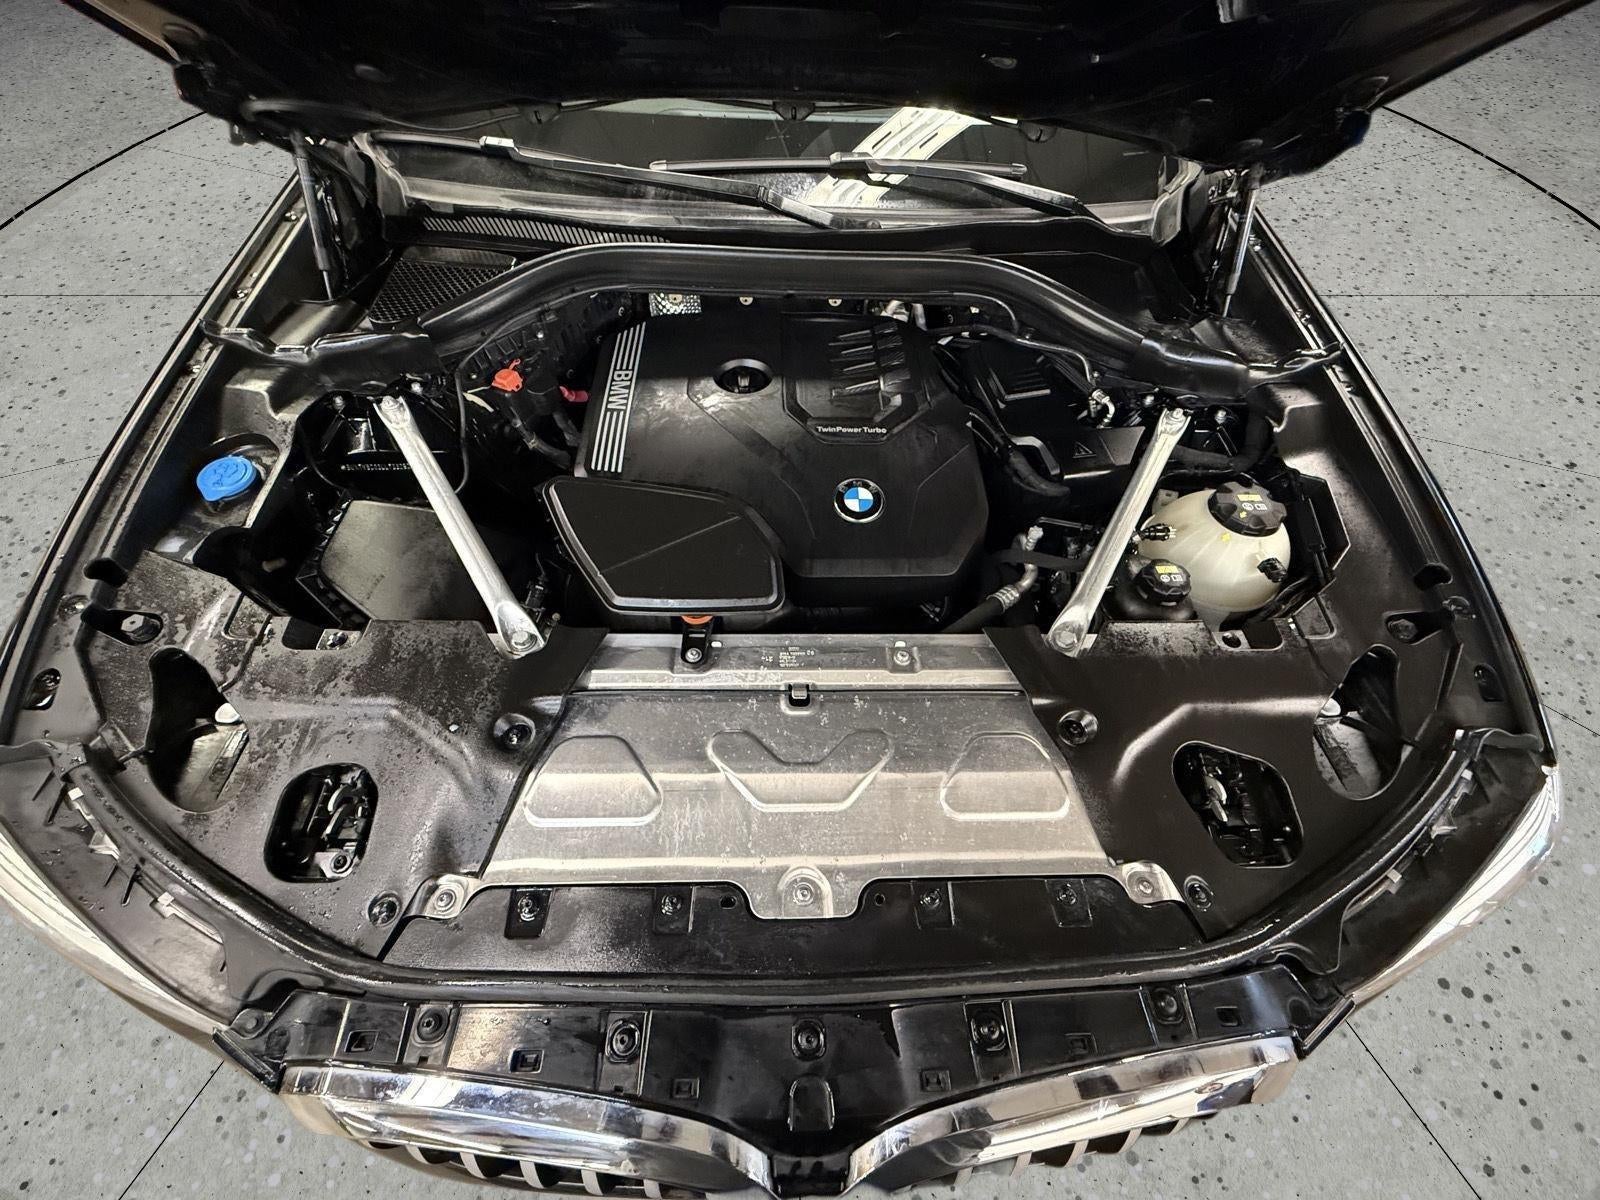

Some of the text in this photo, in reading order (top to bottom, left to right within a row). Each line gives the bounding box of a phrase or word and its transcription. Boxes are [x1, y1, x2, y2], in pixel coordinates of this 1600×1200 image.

[607, 370, 633, 410] BMW
[816, 425, 888, 434] TwinPower Turbo
[838, 480, 879, 494] BMW
